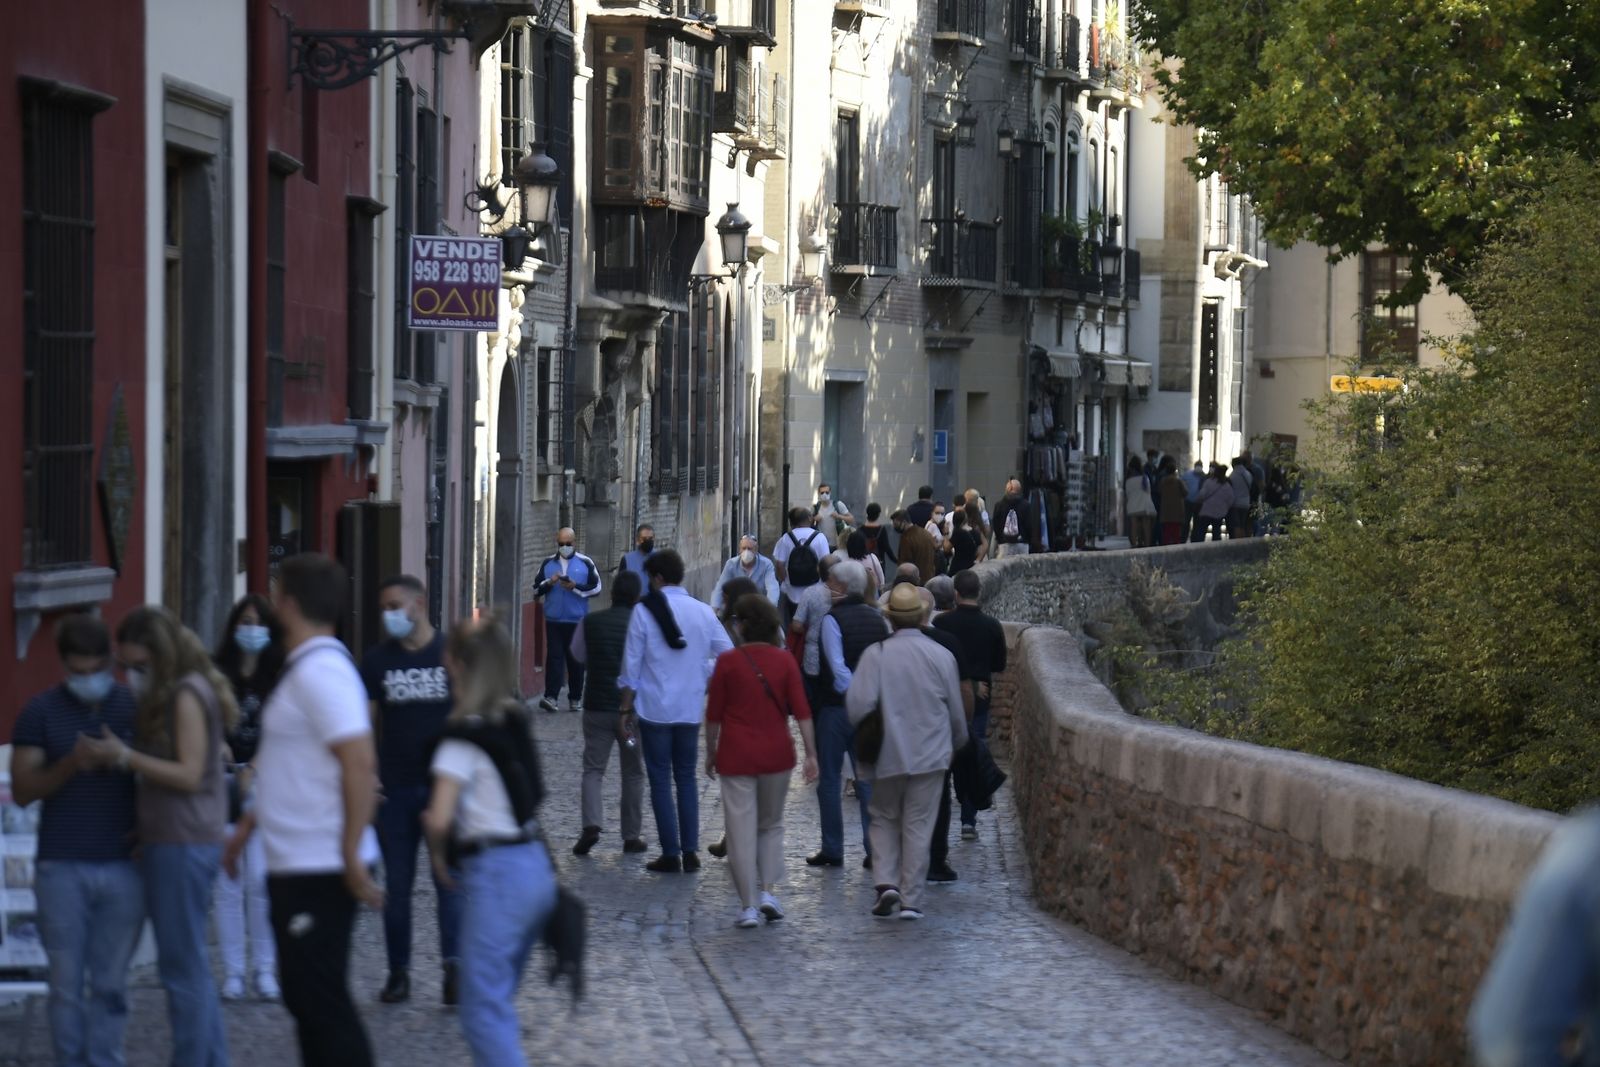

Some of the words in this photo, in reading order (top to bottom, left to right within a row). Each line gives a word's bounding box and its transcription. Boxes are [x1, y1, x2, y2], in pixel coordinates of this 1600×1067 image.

[415, 240, 498, 260] VENDE
[415, 260, 440, 281] 958
[443, 261, 469, 283] 228
[472, 262, 498, 283] 930
[413, 287, 496, 317] OASIS
[413, 318, 497, 328] www.aloasis.com
[385, 682, 448, 701] JONES
